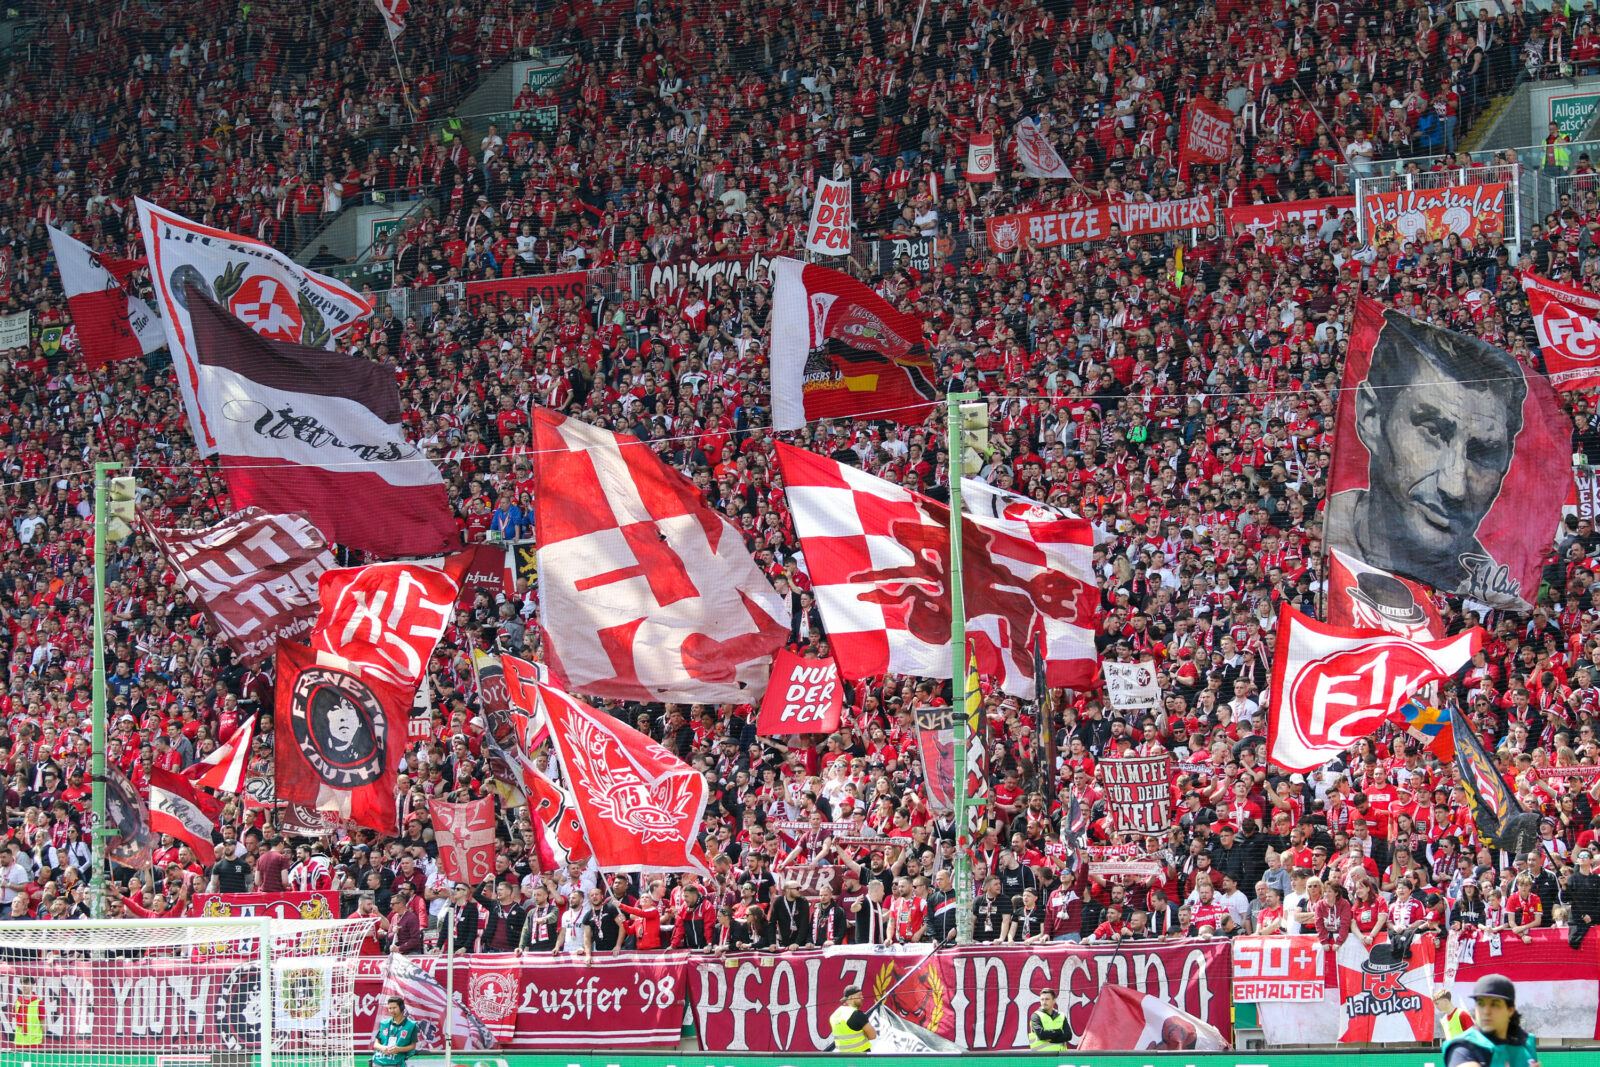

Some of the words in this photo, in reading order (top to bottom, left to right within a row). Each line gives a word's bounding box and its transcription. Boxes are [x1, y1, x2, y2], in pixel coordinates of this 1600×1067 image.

[1555, 102, 1598, 119] Allgäuer
[1190, 109, 1231, 147] BETZE
[820, 184, 850, 206] NUR
[1367, 185, 1504, 225] Höllenteufel
[816, 204, 850, 228] DER
[1029, 208, 1101, 244] BETZE
[1108, 195, 1211, 232] SUPPORTERS
[812, 226, 850, 250] FCK
[790, 664, 837, 684] NUR
[785, 681, 836, 703] DER
[780, 701, 832, 723] FCK
[299, 735, 381, 784] YOUTH
[1102, 760, 1168, 784] KÄMPFE
[1106, 785, 1134, 802] FÜR
[1136, 782, 1170, 801] DEINE
[1111, 800, 1171, 833] ZIELE
[1234, 938, 1324, 978] 50+1
[517, 975, 628, 1021] Luzifer
[632, 971, 676, 1013] '98
[1234, 983, 1324, 1001] ERHALTEN
[1363, 970, 1411, 1000] FCK
[1346, 992, 1421, 1018] Halunken
